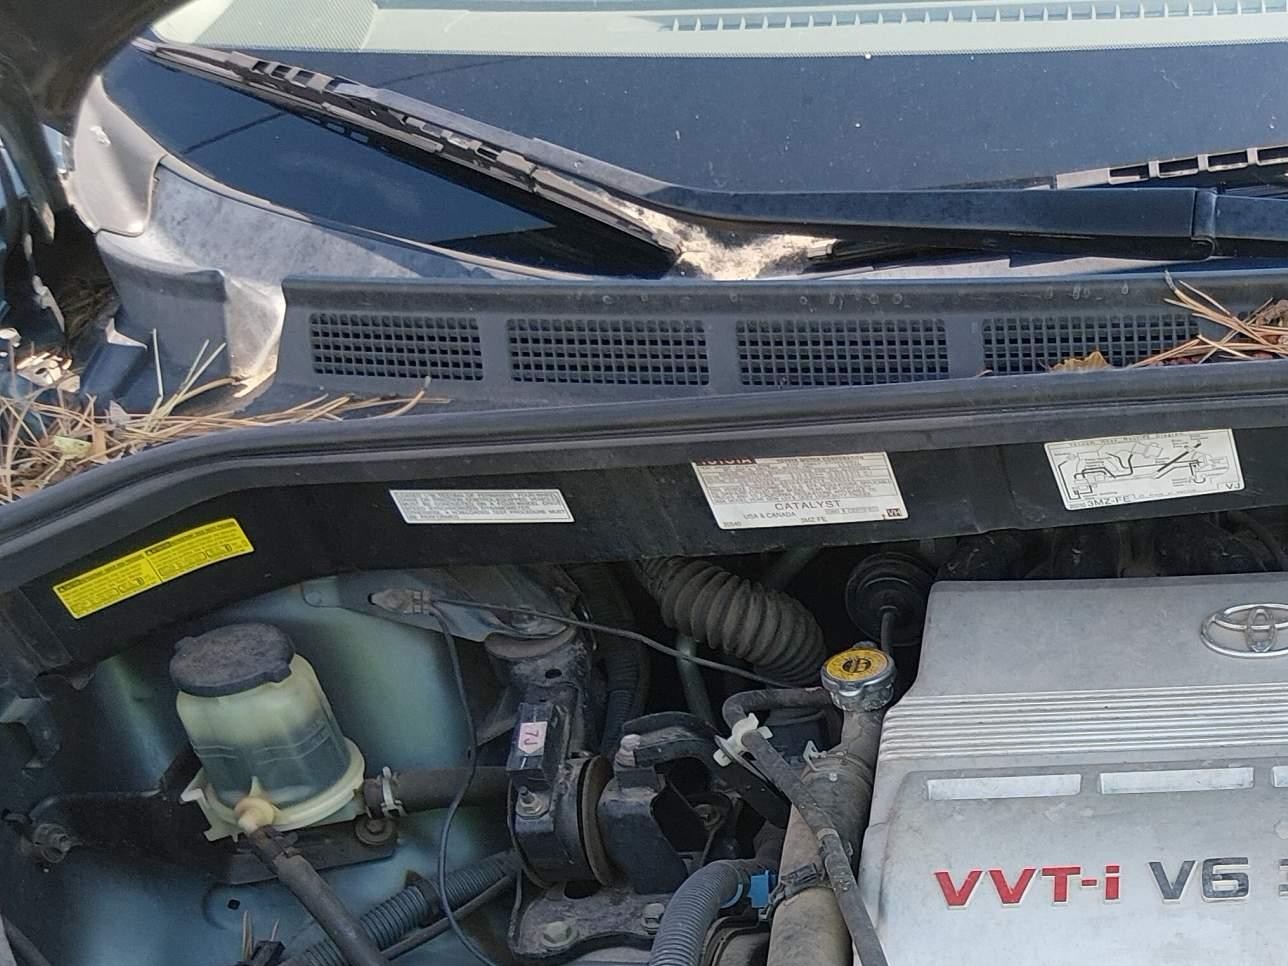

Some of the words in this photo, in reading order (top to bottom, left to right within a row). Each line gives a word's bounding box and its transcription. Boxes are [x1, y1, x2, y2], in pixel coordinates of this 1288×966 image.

[774, 499, 842, 511] CATALYST
[1087, 494, 1131, 506] 3MZ-FE
[934, 864, 1122, 910] VVT-i
[1148, 857, 1251, 904] V6
